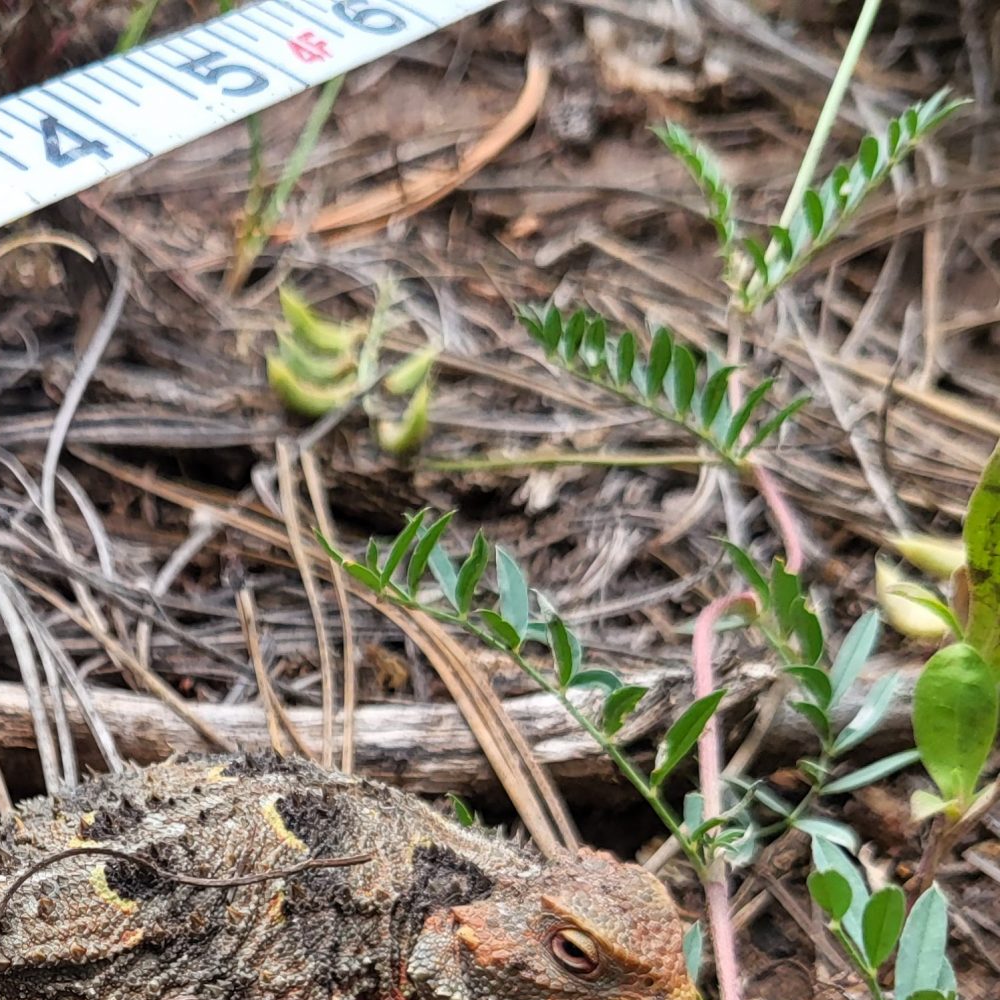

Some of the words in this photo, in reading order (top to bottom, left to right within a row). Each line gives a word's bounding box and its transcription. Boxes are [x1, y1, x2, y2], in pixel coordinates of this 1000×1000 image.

[40, 115, 113, 168] 4
[176, 50, 269, 97] 5
[332, 0, 407, 36] 6
